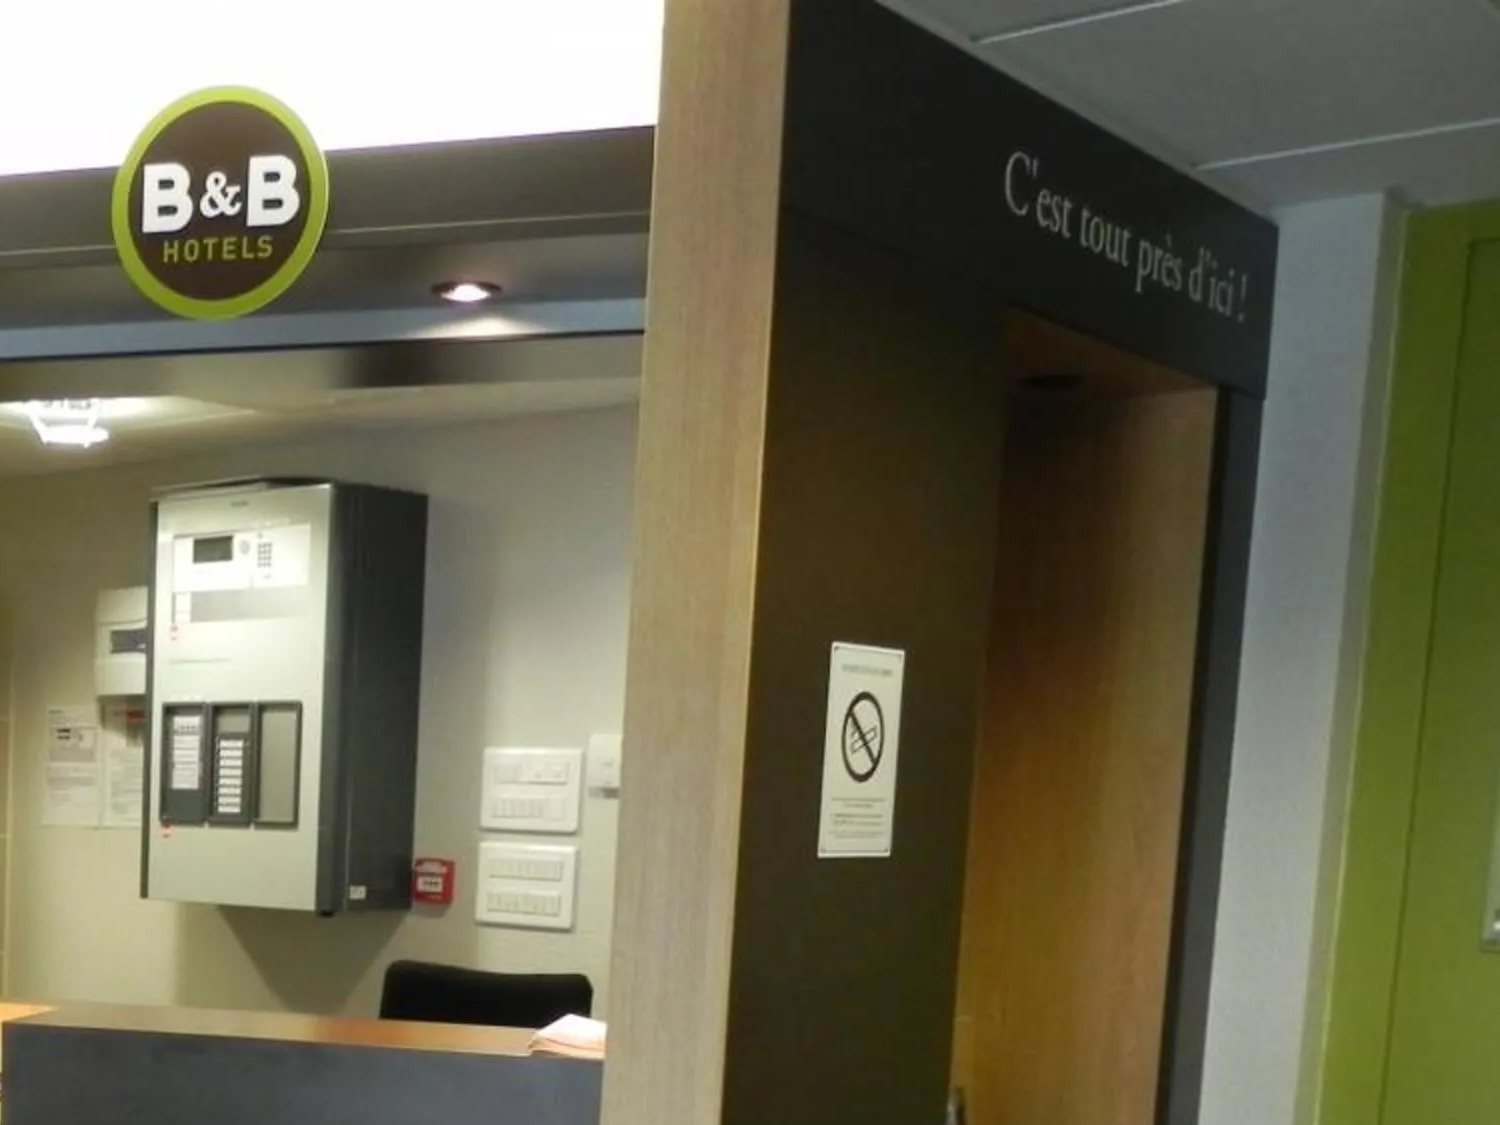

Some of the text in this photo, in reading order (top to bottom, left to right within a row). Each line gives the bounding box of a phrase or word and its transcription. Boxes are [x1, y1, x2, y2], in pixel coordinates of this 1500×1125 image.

[142, 154, 300, 234] B&B
[1004, 150, 1073, 239] C'est
[1079, 206, 1132, 268] tout
[1135, 232, 1182, 294] près
[163, 234, 274, 264] HOTELS
